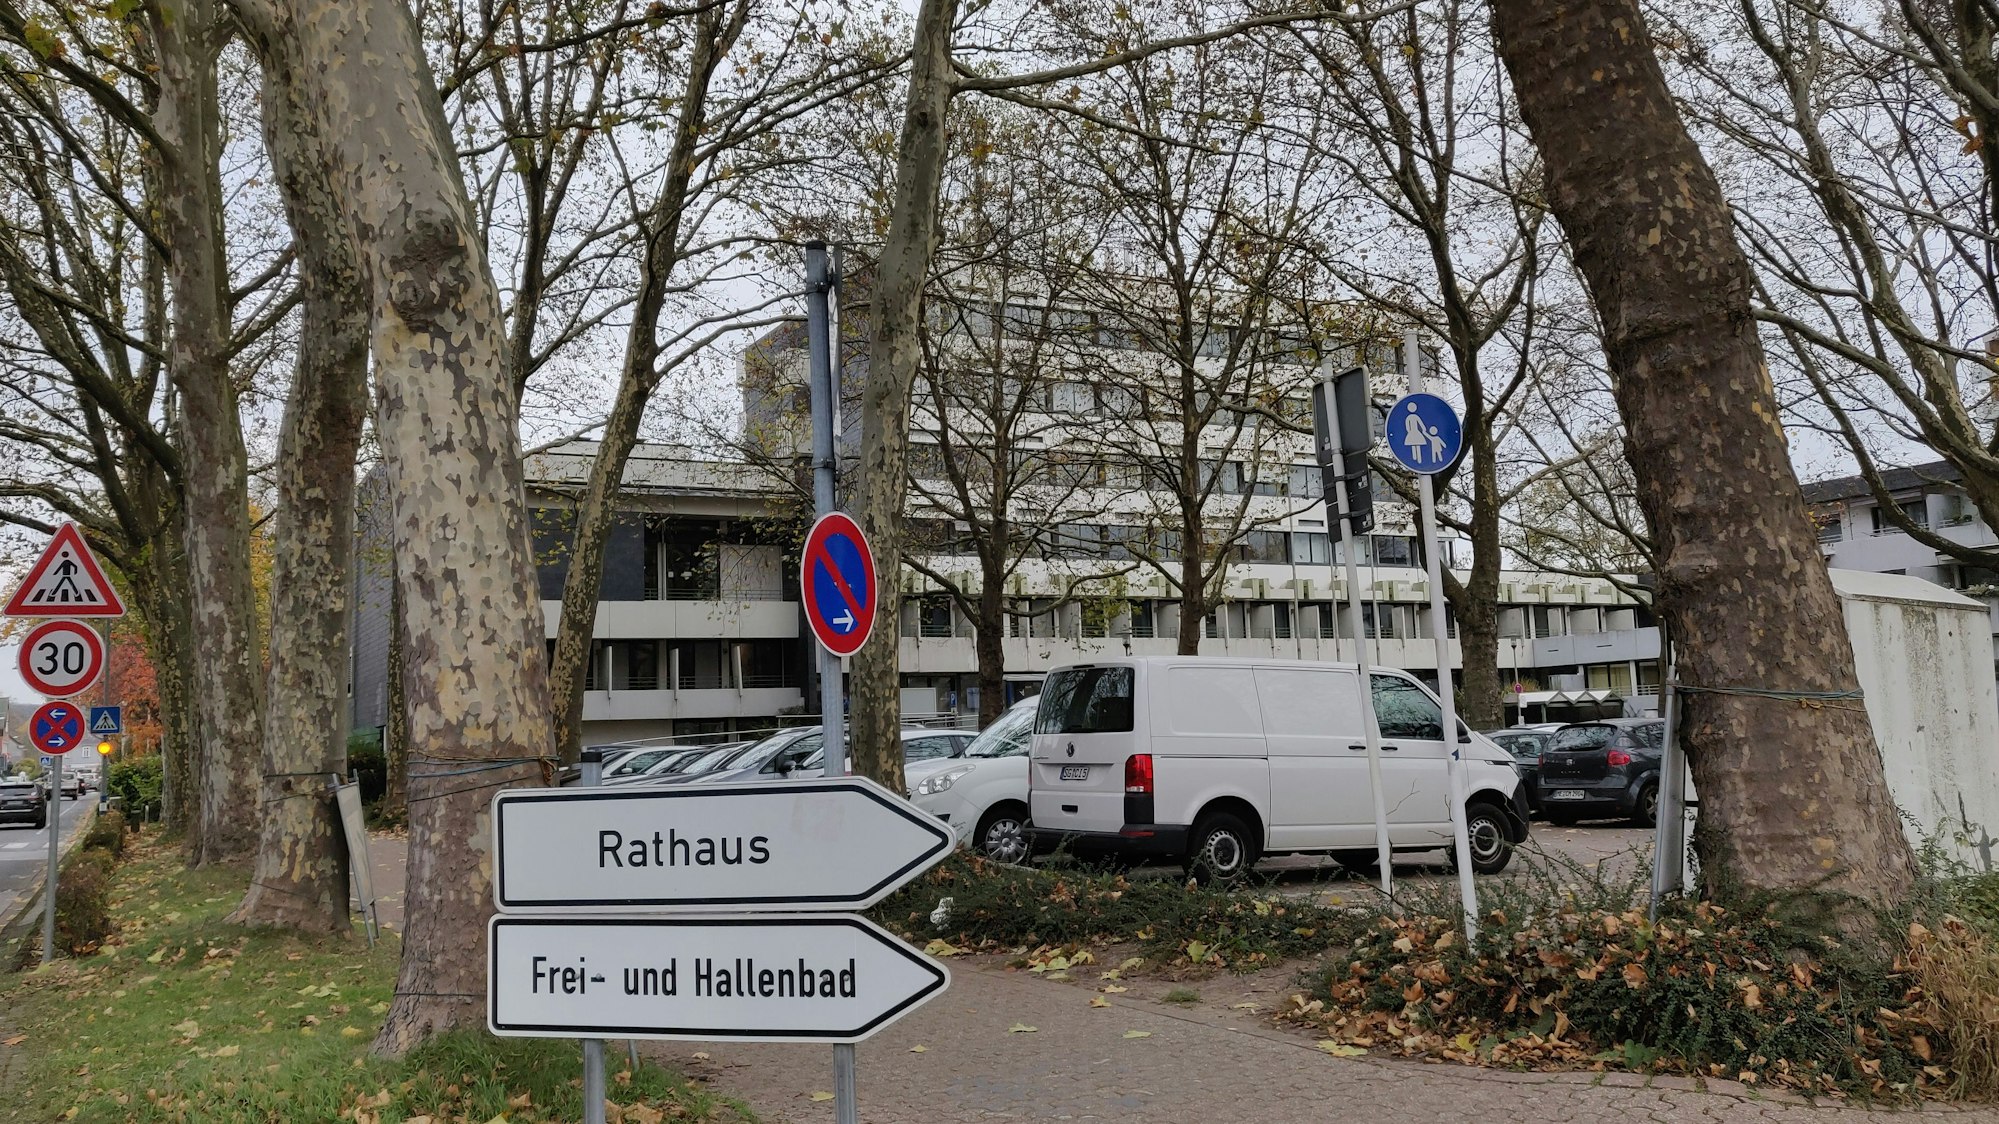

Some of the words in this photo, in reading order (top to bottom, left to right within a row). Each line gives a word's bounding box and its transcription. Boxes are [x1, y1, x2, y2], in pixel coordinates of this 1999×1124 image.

[37, 641, 84, 675] 30
[599, 829, 770, 868] Rathaus
[532, 956, 606, 995] Frei-
[623, 957, 677, 997] und
[695, 958, 856, 998] Hallenbad
